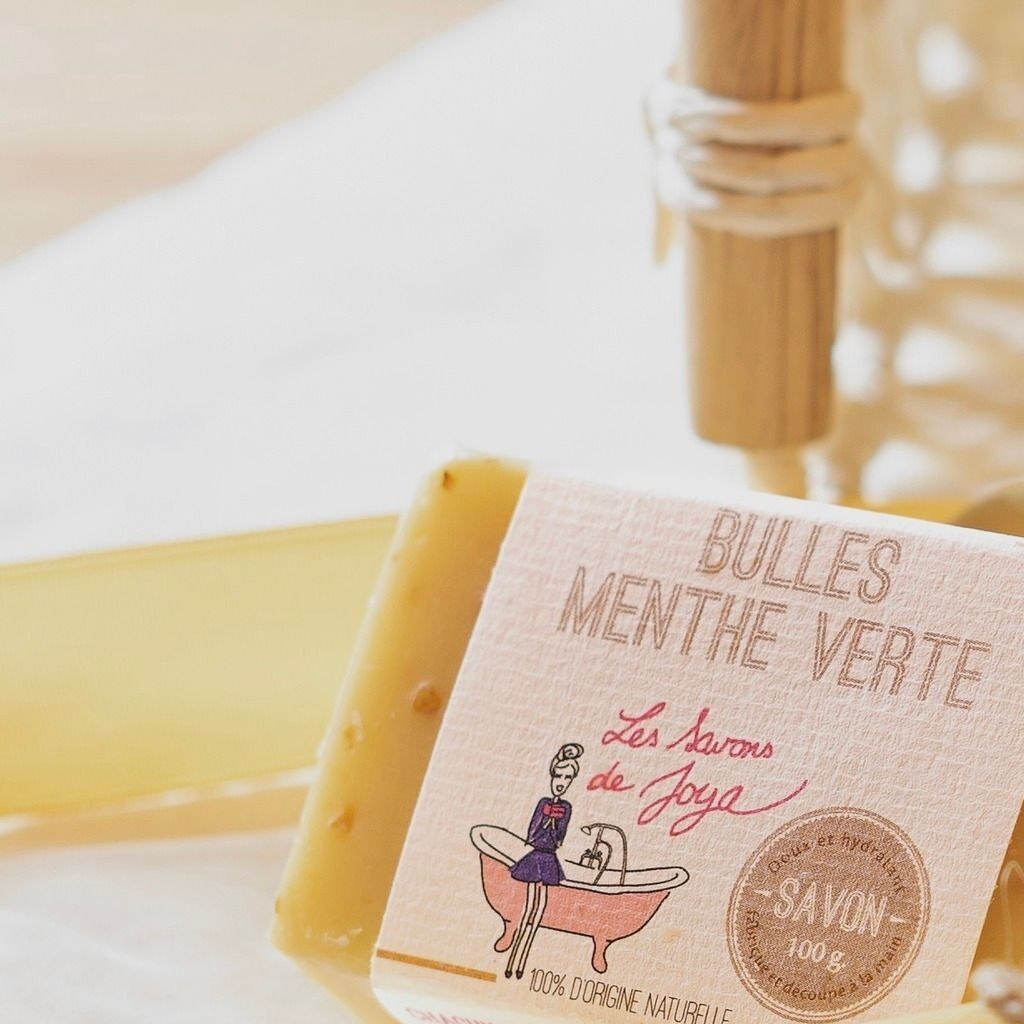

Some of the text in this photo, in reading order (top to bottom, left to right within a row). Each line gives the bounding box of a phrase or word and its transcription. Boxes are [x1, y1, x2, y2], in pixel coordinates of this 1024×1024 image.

[698, 507, 902, 604] BULLES
[557, 566, 992, 710] MENTHE VERTE
[602, 702, 775, 759] Les Savons
[587, 761, 808, 836] de Joya
[817, 833, 834, 847] et
[773, 877, 888, 938] SAVON
[529, 967, 567, 996] 100%
[569, 976, 642, 1014] D'ORIGINE
[859, 973, 873, 986] la
[876, 936, 901, 973] main
